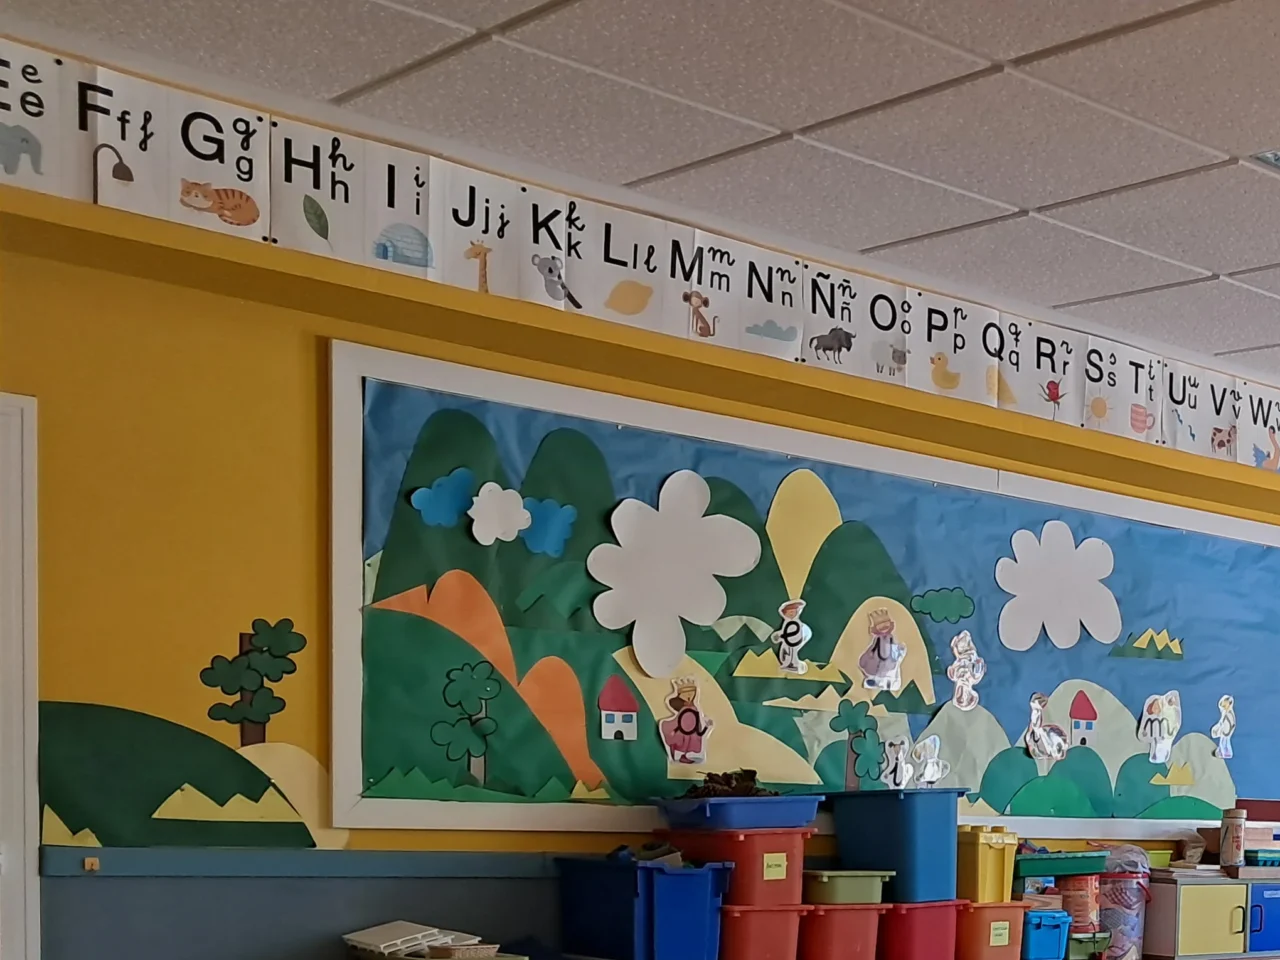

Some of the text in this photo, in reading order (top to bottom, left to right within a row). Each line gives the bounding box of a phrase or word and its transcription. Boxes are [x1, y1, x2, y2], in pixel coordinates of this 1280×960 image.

[78, 81, 113, 131] F
[181, 112, 224, 164] G
[284, 138, 320, 190] H
[388, 164, 395, 208] I
[452, 186, 475, 227] J
[532, 204, 562, 250] K
[604, 223, 628, 267] L
[670, 240, 703, 285] M
[748, 261, 773, 303] N
[812, 272, 835, 318] Ñ
[870, 294, 896, 331] O
[927, 308, 948, 342] P
[983, 323, 1004, 361] Q
[1037, 337, 1056, 373] R
[1085, 349, 1103, 382] S
[1129, 361, 1144, 393] T
[1169, 372, 1186, 405] U
[1211, 384, 1227, 415] V
[1250, 395, 1272, 427] W
[781, 620, 803, 648] e
[676, 708, 708, 736] a
[1143, 717, 1176, 737] m
